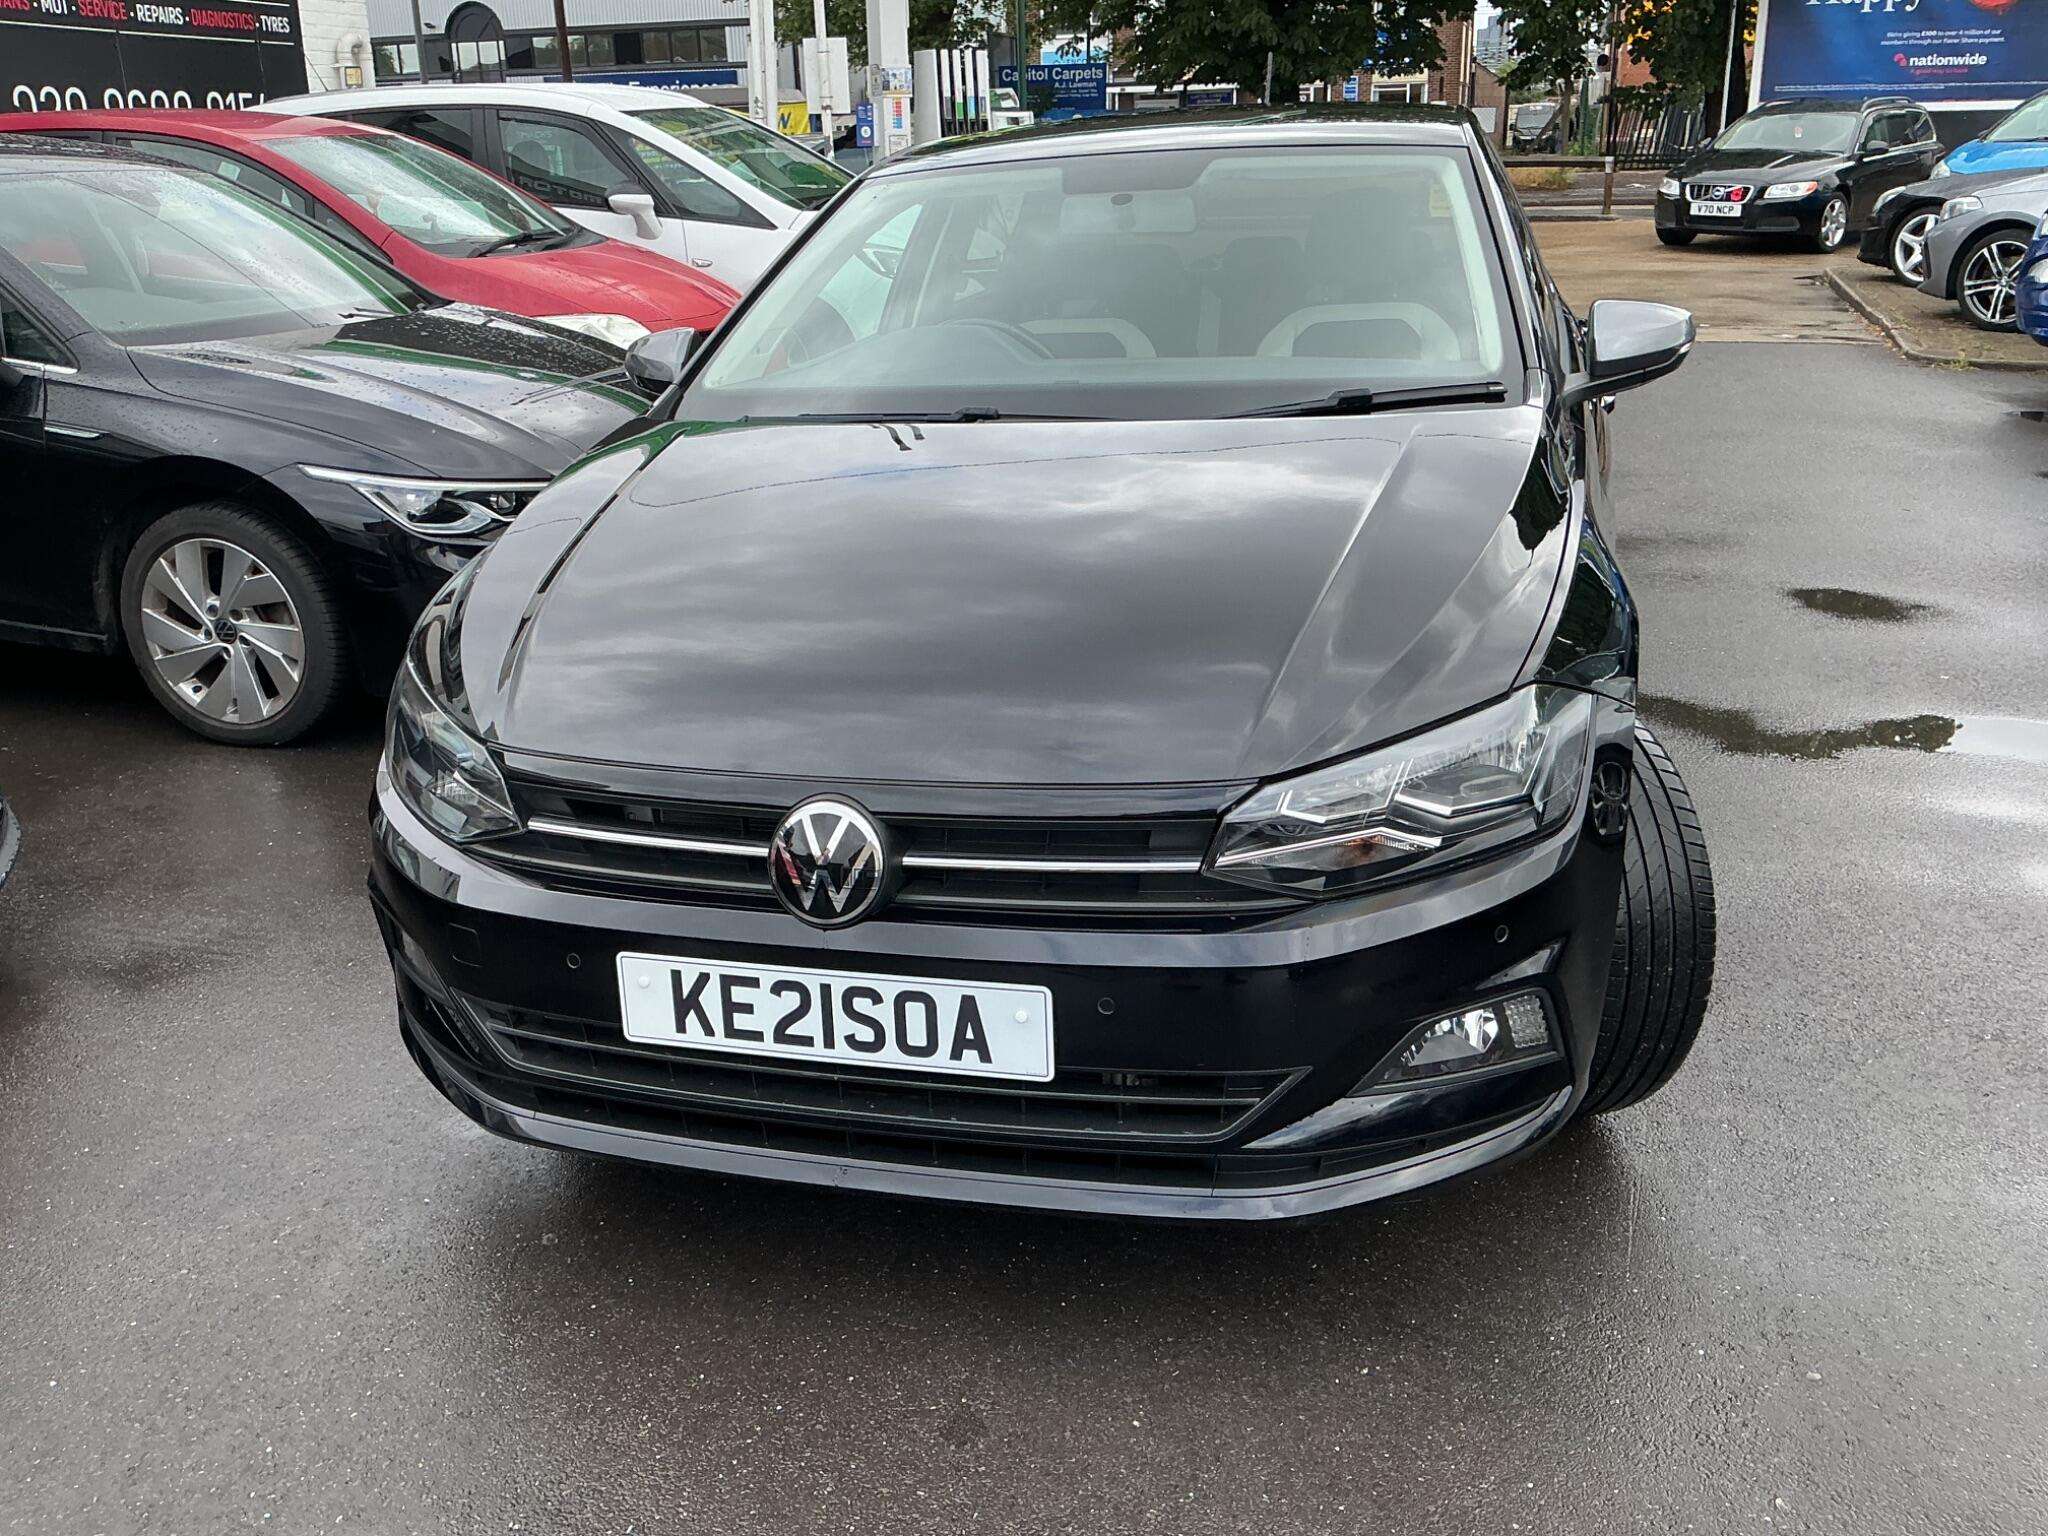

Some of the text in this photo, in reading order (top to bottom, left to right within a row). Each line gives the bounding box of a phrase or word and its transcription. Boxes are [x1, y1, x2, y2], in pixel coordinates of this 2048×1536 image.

[0, 0, 31, 10] ANS
[77, 0, 128, 20] SERVICE
[135, 4, 184, 25] REPAIRS
[190, 9, 255, 31] DIAGNOSTICS
[260, 15, 291, 33] TYRES
[1909, 53, 1988, 66] nationwide
[1002, 66, 1103, 82] Caitol Carpets
[1697, 204, 1735, 215] V70 NCP
[670, 968, 993, 1065] KE21SOA
